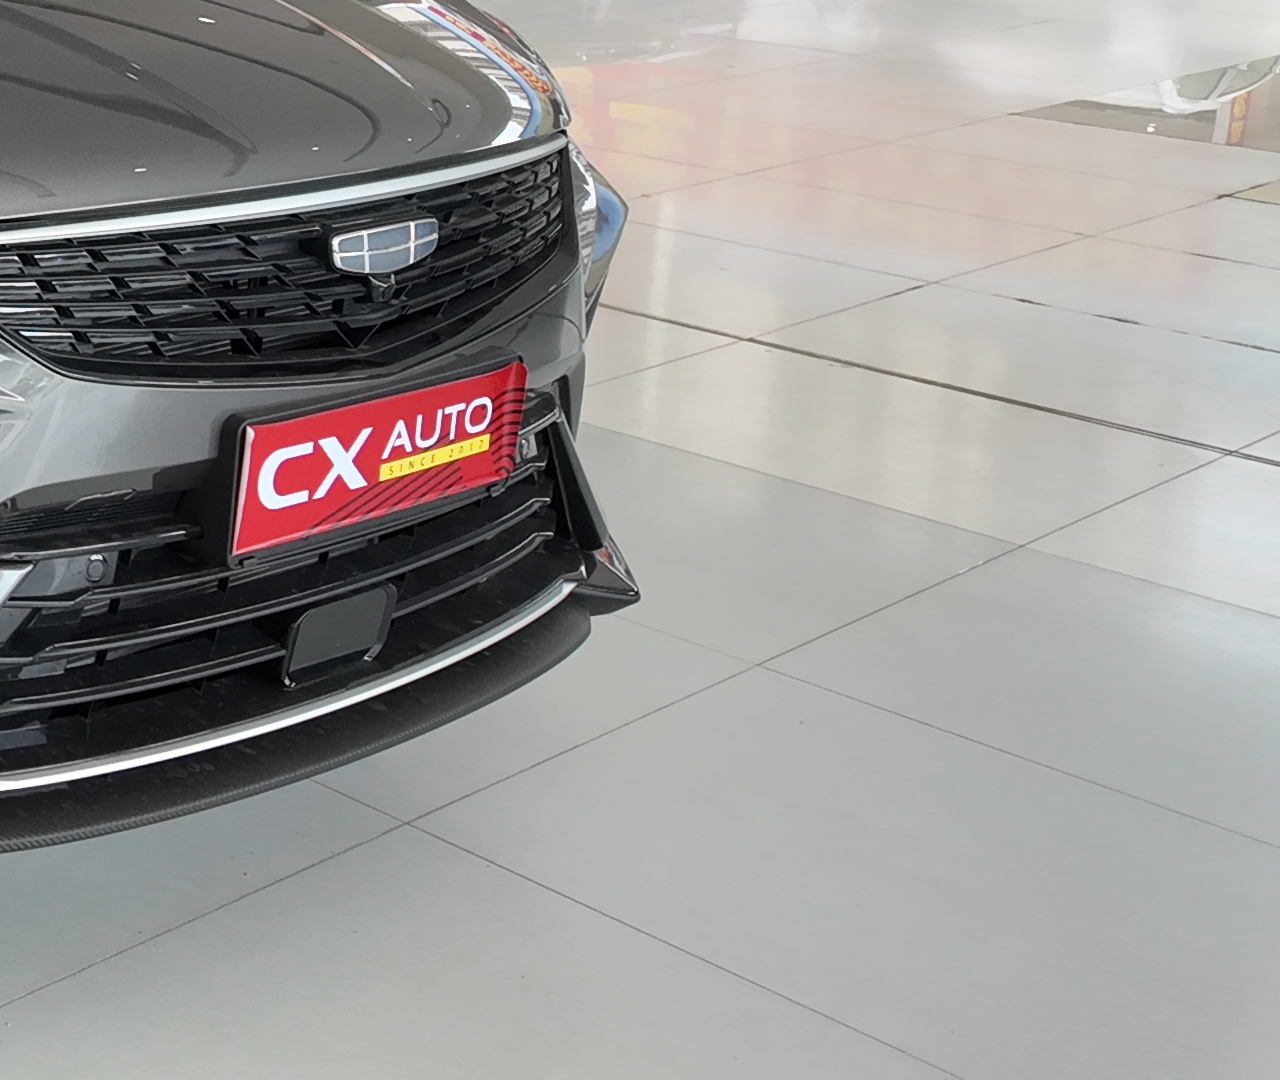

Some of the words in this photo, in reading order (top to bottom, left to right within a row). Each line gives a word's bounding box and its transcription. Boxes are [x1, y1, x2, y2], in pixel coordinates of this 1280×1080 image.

[257, 427, 373, 510] CX
[381, 396, 493, 460] AUTO
[388, 454, 436, 476] SINCE
[448, 439, 485, 459] 2012
